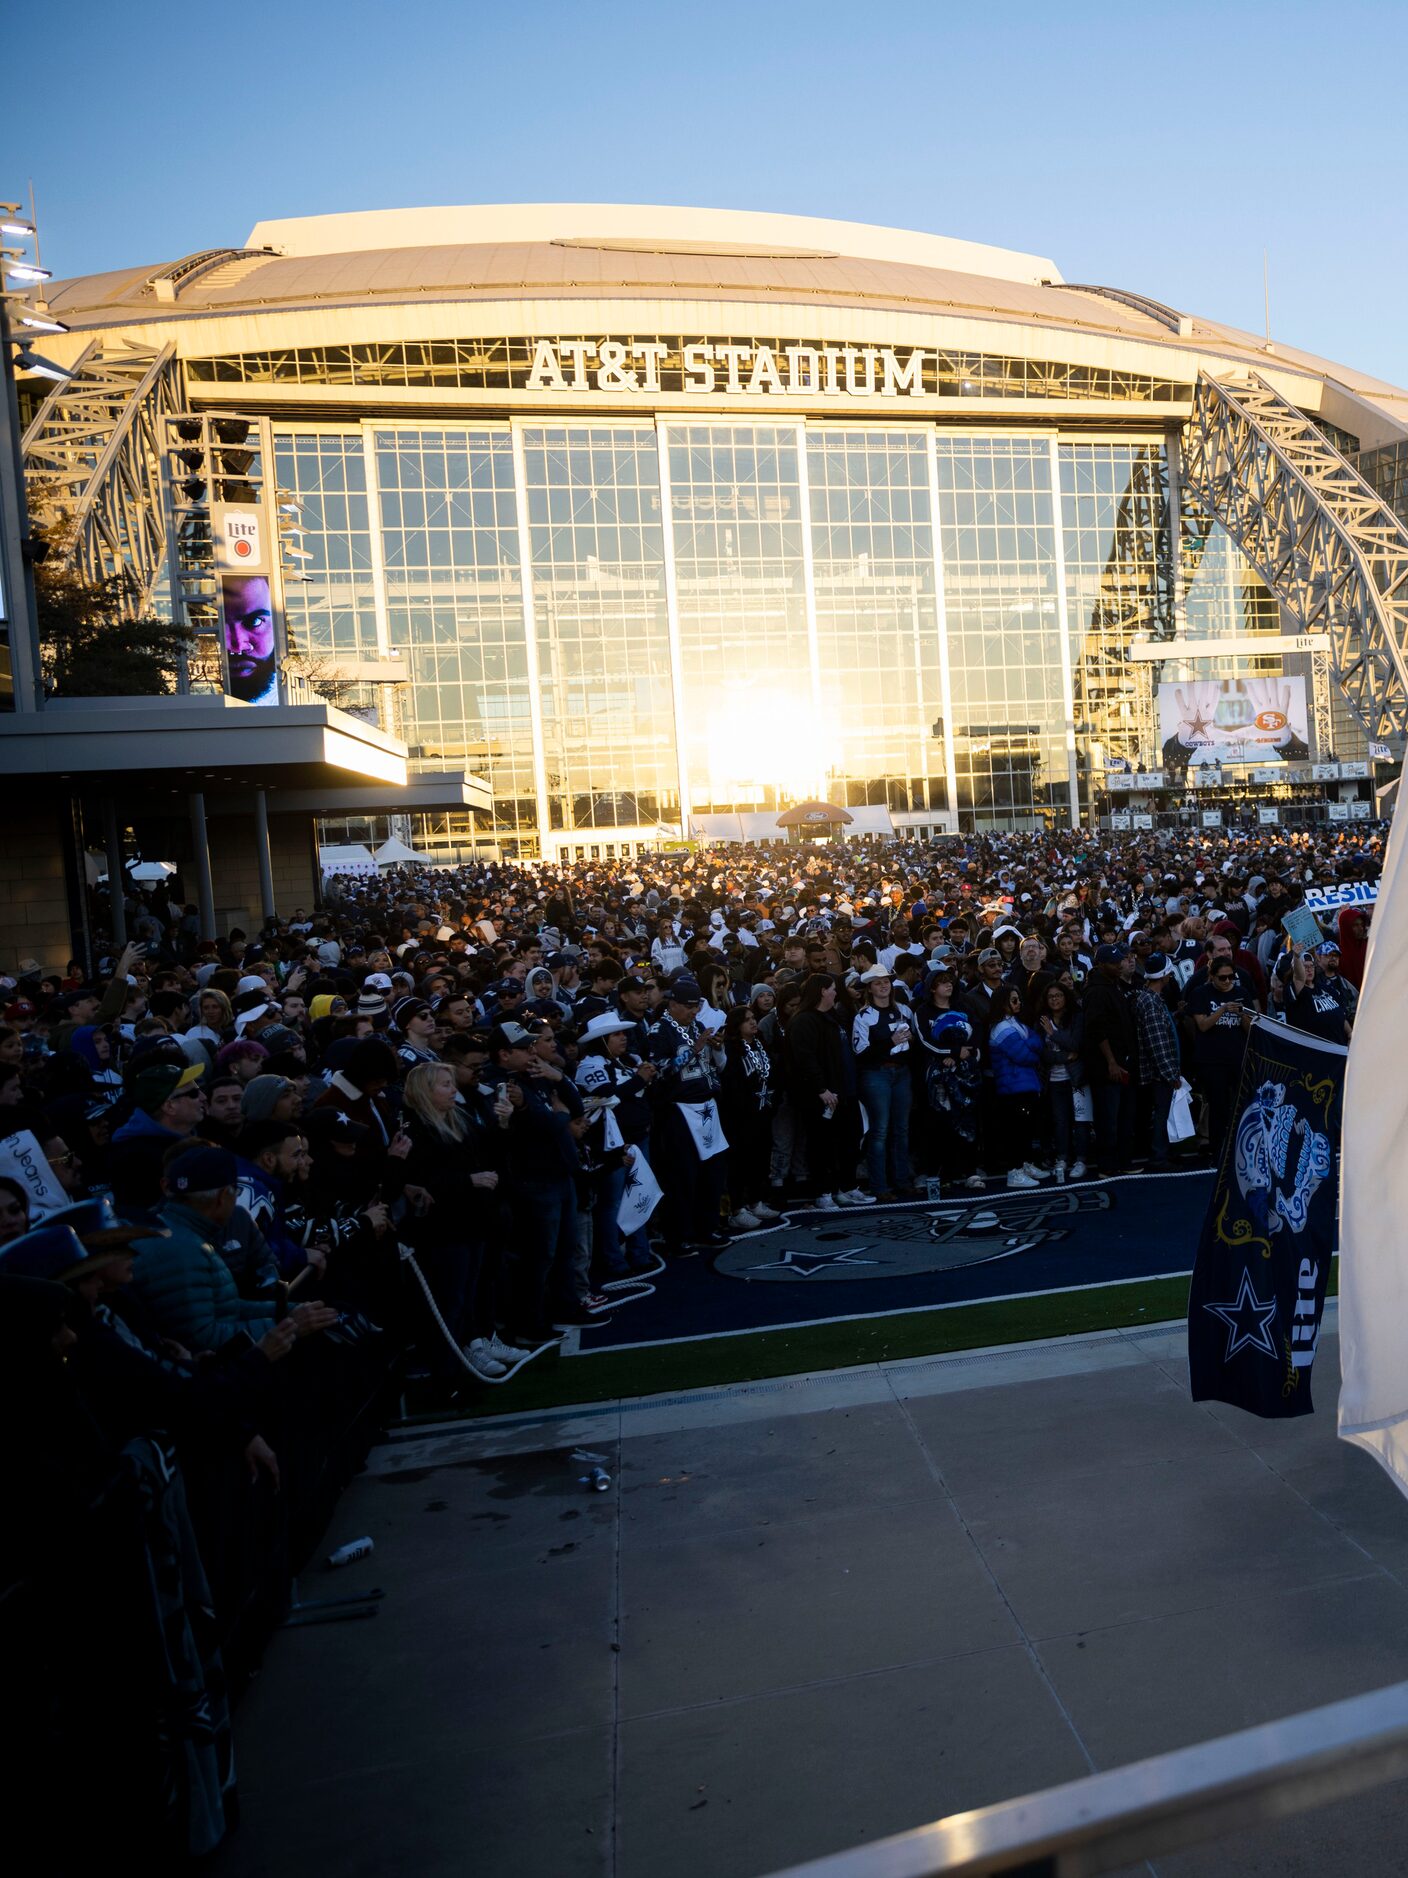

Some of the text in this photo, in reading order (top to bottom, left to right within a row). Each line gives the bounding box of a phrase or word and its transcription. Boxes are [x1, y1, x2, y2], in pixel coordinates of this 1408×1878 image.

[526, 340, 926, 397] AT&T STADIUM
[227, 522, 256, 538] Lite
[1296, 638, 1314, 649] Lite
[1184, 740, 1216, 748] COWBOYS
[584, 1070, 608, 1085] 88
[13, 1147, 49, 1197] Jeans
[1291, 1257, 1321, 1374] Lite
